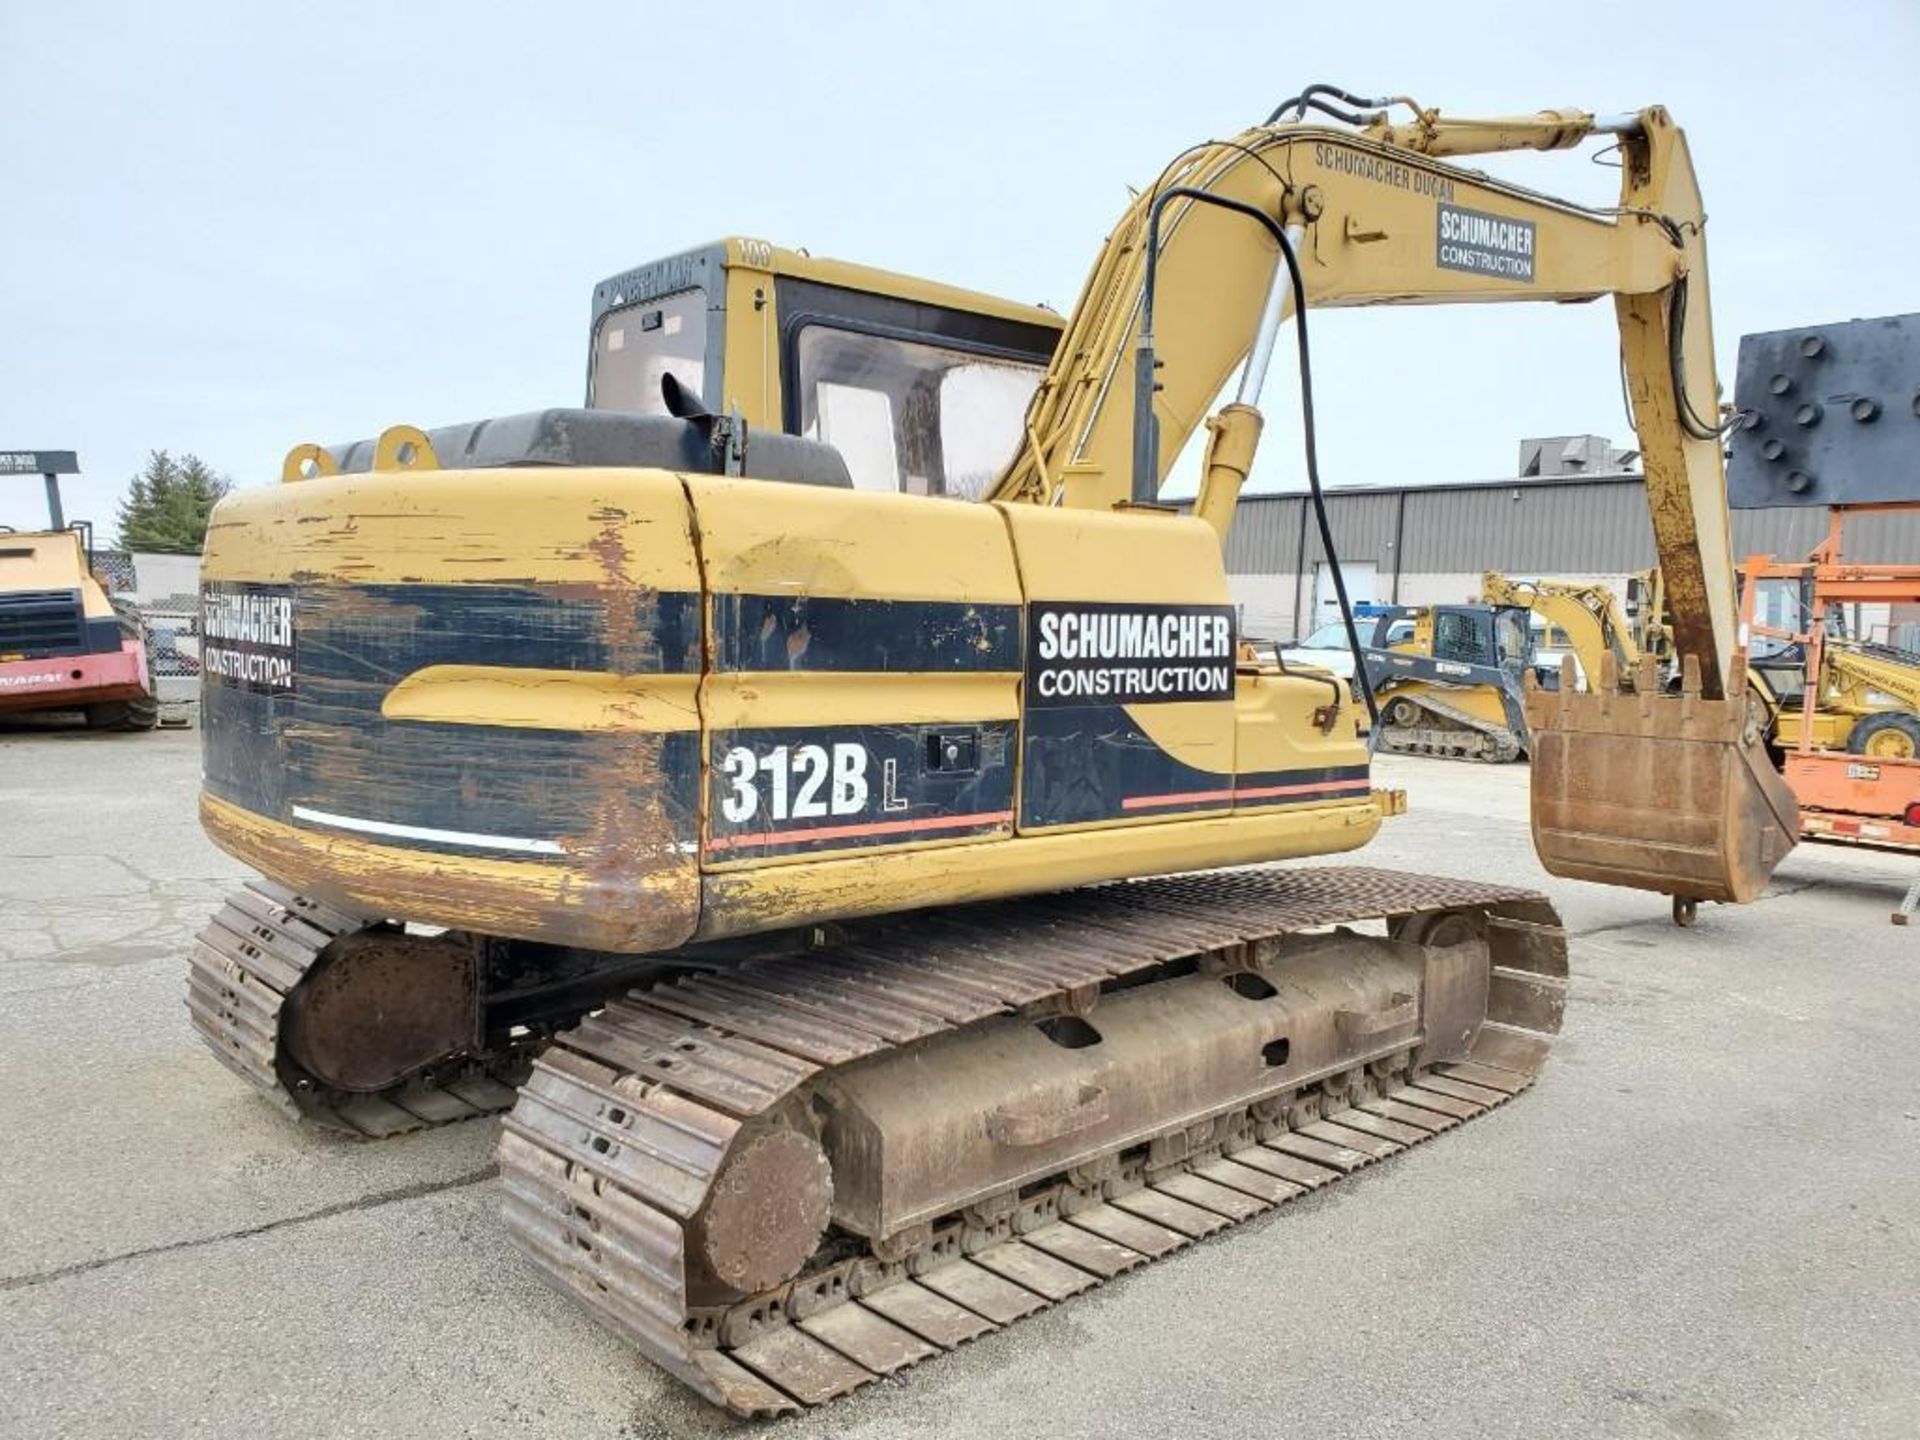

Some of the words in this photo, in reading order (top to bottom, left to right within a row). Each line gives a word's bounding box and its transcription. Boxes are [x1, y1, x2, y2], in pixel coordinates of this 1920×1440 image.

[1315, 144, 1410, 190] SCHUMACHER
[1441, 210, 1532, 255] SCHUMACHER
[1441, 245, 1532, 276] CONSTRUCTION
[205, 593, 292, 647] SCHUMACHER
[1039, 612, 1230, 660] SCHUMACHER
[205, 647, 292, 688] CONSTRUCTION
[1038, 666, 1229, 697] CONSTRUCTION
[722, 742, 868, 823] 312B
[883, 758, 908, 812] L
